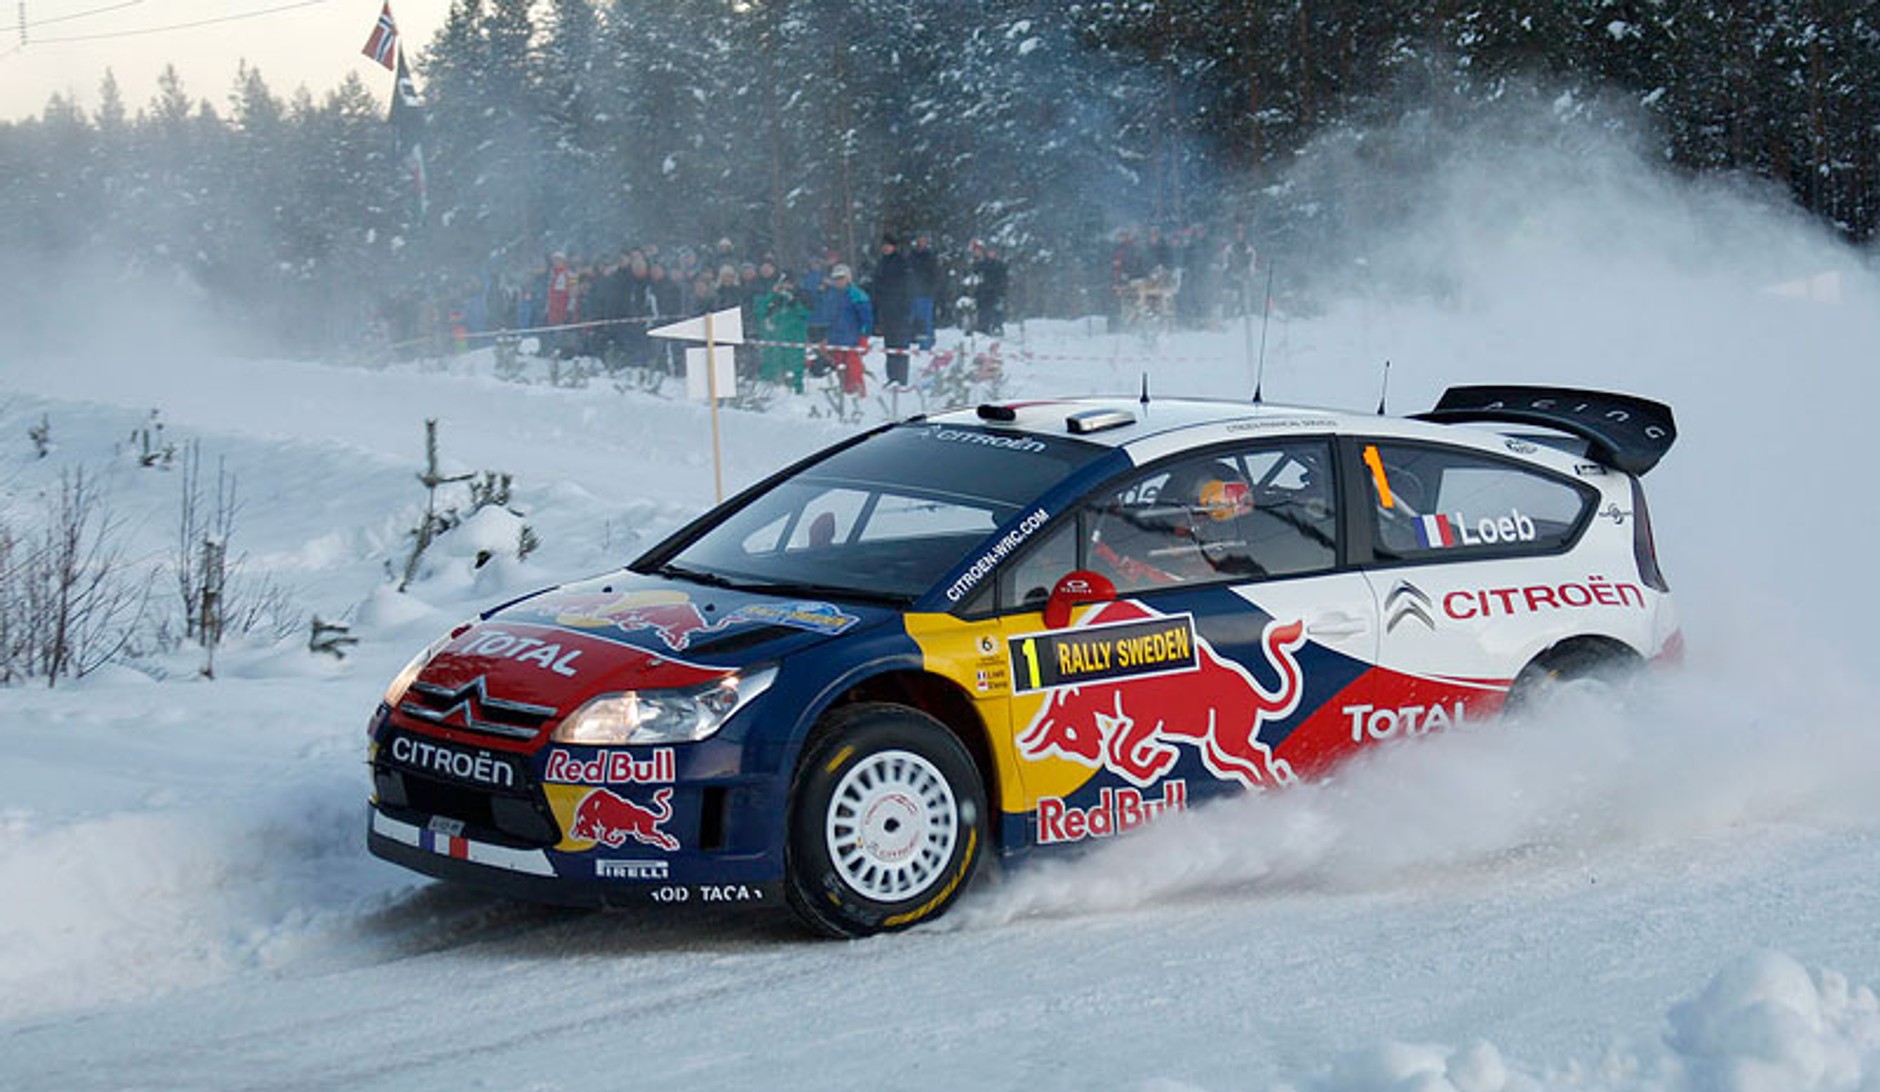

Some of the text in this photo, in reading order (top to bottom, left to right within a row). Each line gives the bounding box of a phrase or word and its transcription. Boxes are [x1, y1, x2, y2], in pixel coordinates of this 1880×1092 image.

[1363, 445, 1395, 508] 1
[1456, 509, 1536, 546] Loeb
[946, 507, 1050, 602] CITROEN-WRC.COM
[459, 629, 583, 677] TOTAL
[1022, 626, 1190, 689] 1 RALLY SWEDEN
[545, 747, 676, 783] Red Bull
[1037, 787, 1112, 844] Red
[596, 859, 669, 878] PIRELLI
